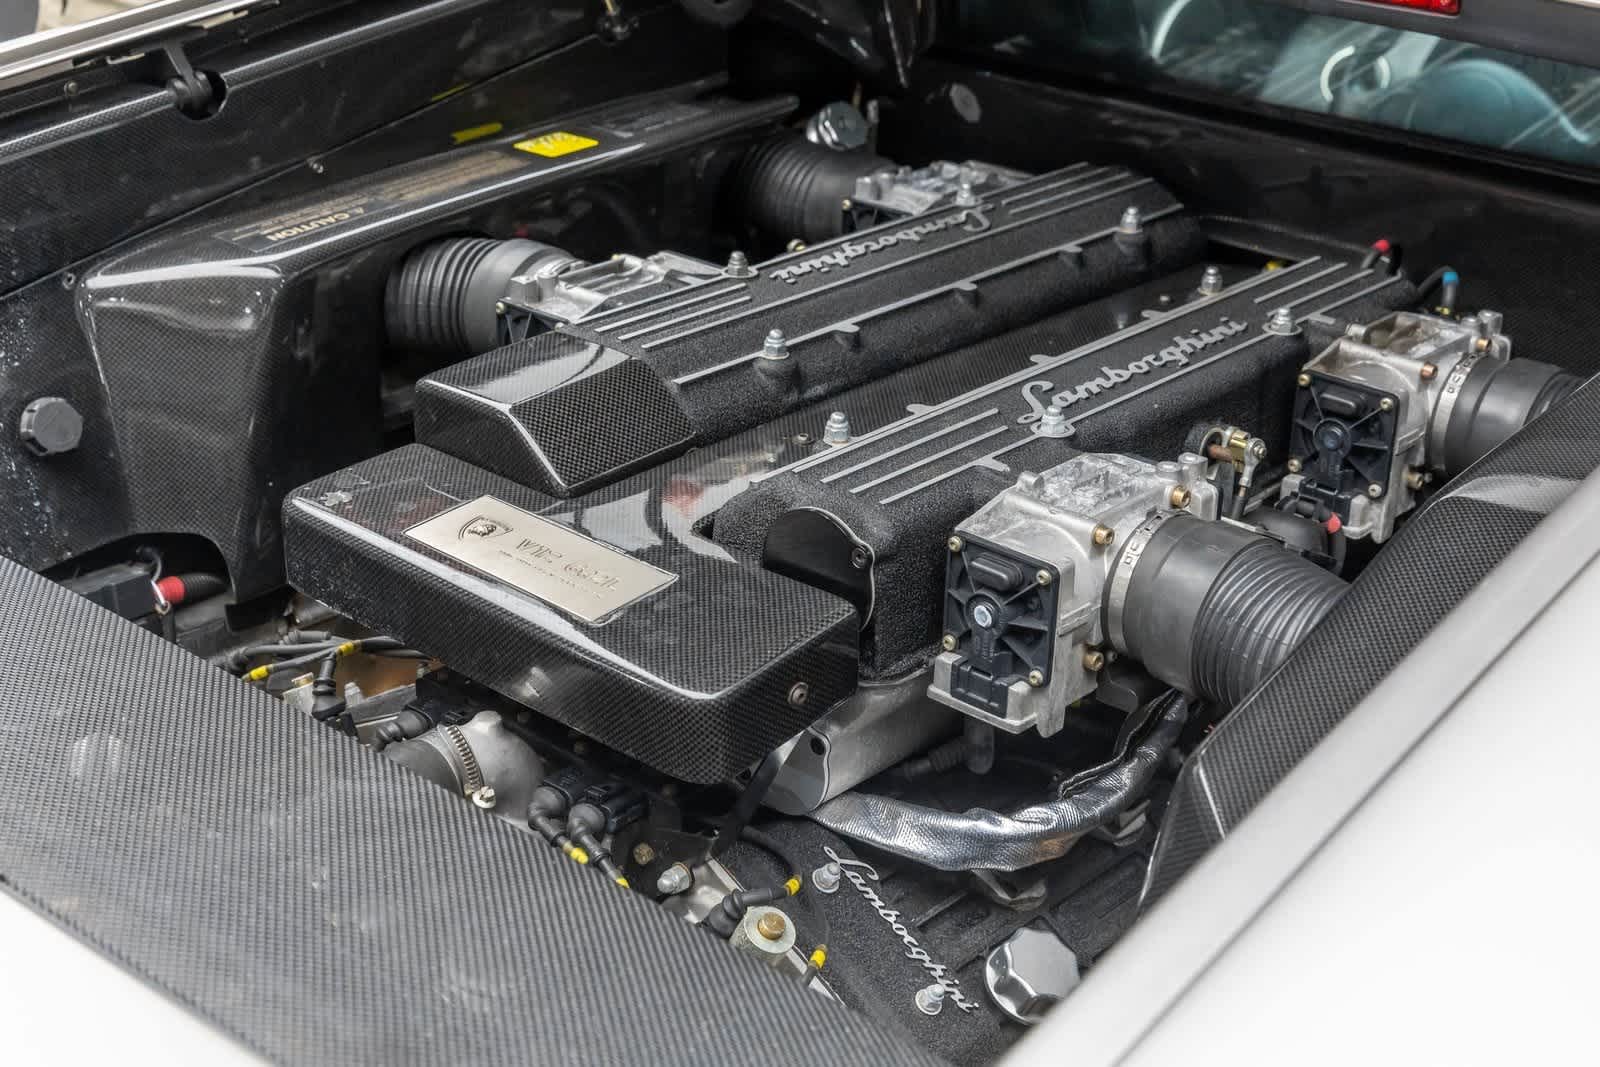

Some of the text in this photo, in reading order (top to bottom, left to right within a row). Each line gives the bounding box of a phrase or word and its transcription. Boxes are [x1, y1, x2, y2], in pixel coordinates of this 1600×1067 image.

[267, 212, 350, 241] CAUTION
[769, 203, 994, 284] Lamborghini
[1017, 317, 1248, 424] Lamborghini
[823, 846, 979, 1013] Lamborghini
